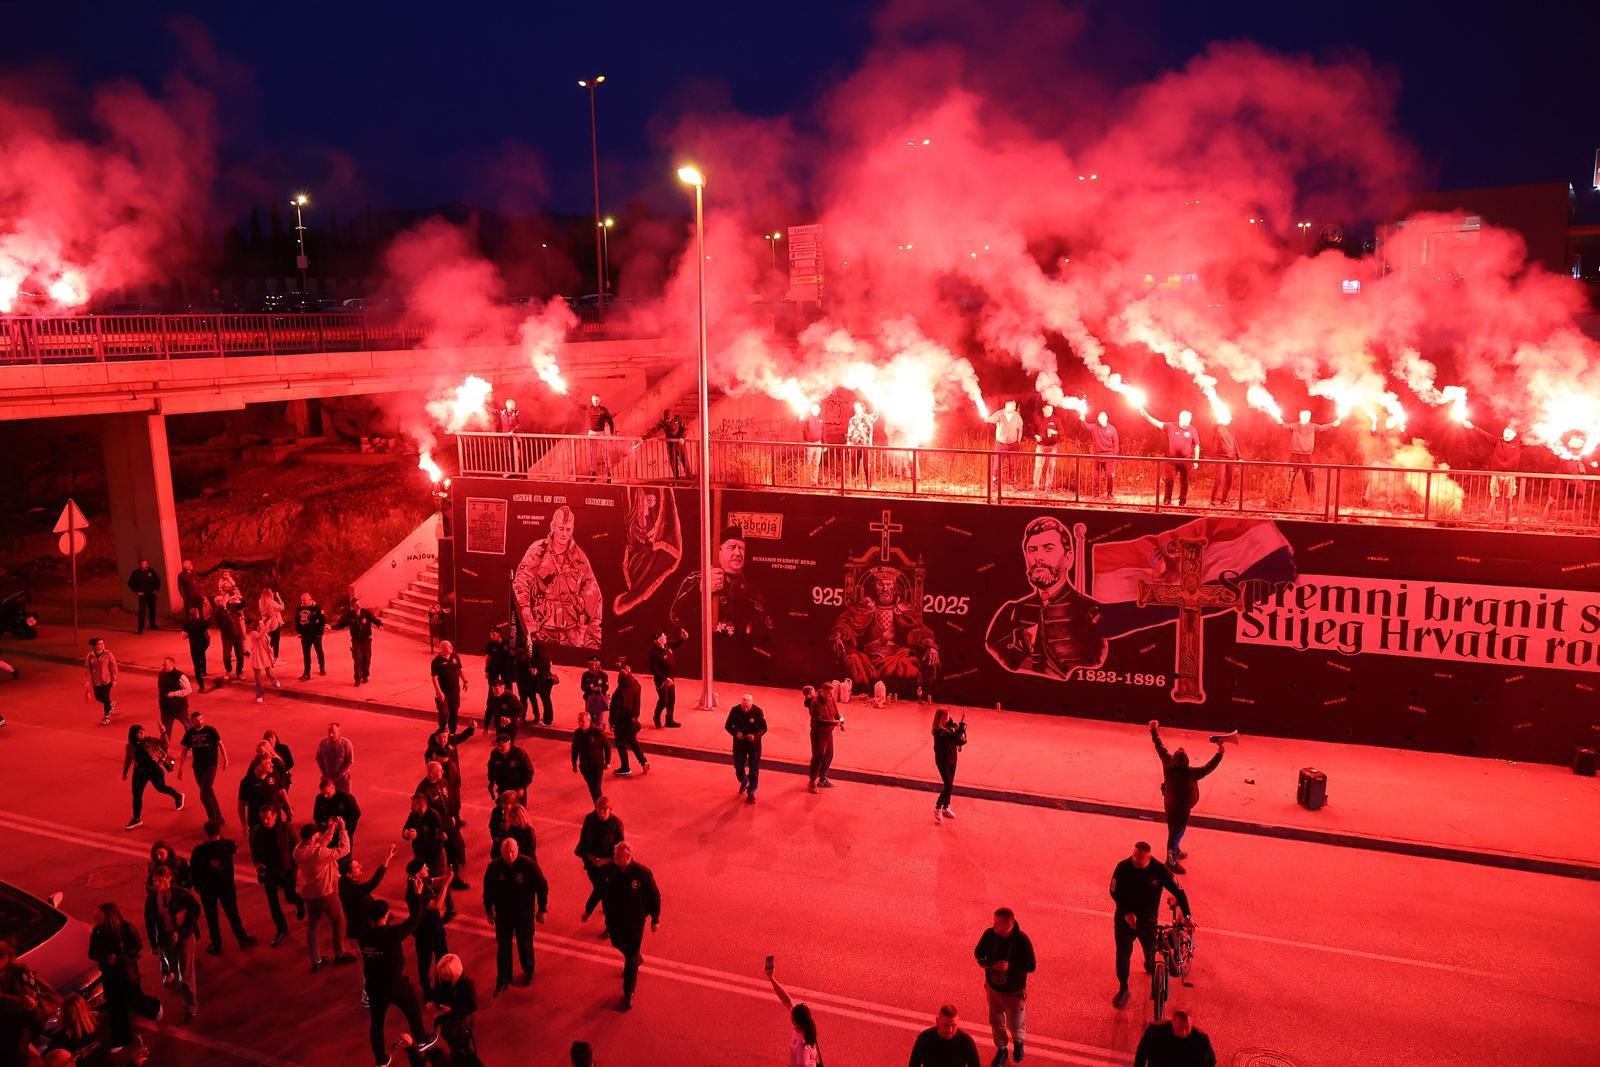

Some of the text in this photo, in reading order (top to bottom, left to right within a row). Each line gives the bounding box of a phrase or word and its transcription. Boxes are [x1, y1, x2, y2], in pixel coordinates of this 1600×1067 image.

[812, 586, 844, 606] 925
[923, 594, 970, 615] 2025
[1218, 570, 1407, 617] Spremni
[1424, 586, 1568, 632] branit
[1241, 606, 1600, 667] Stijeg Hrvata ro
[1077, 669, 1166, 687] 1823-1896
